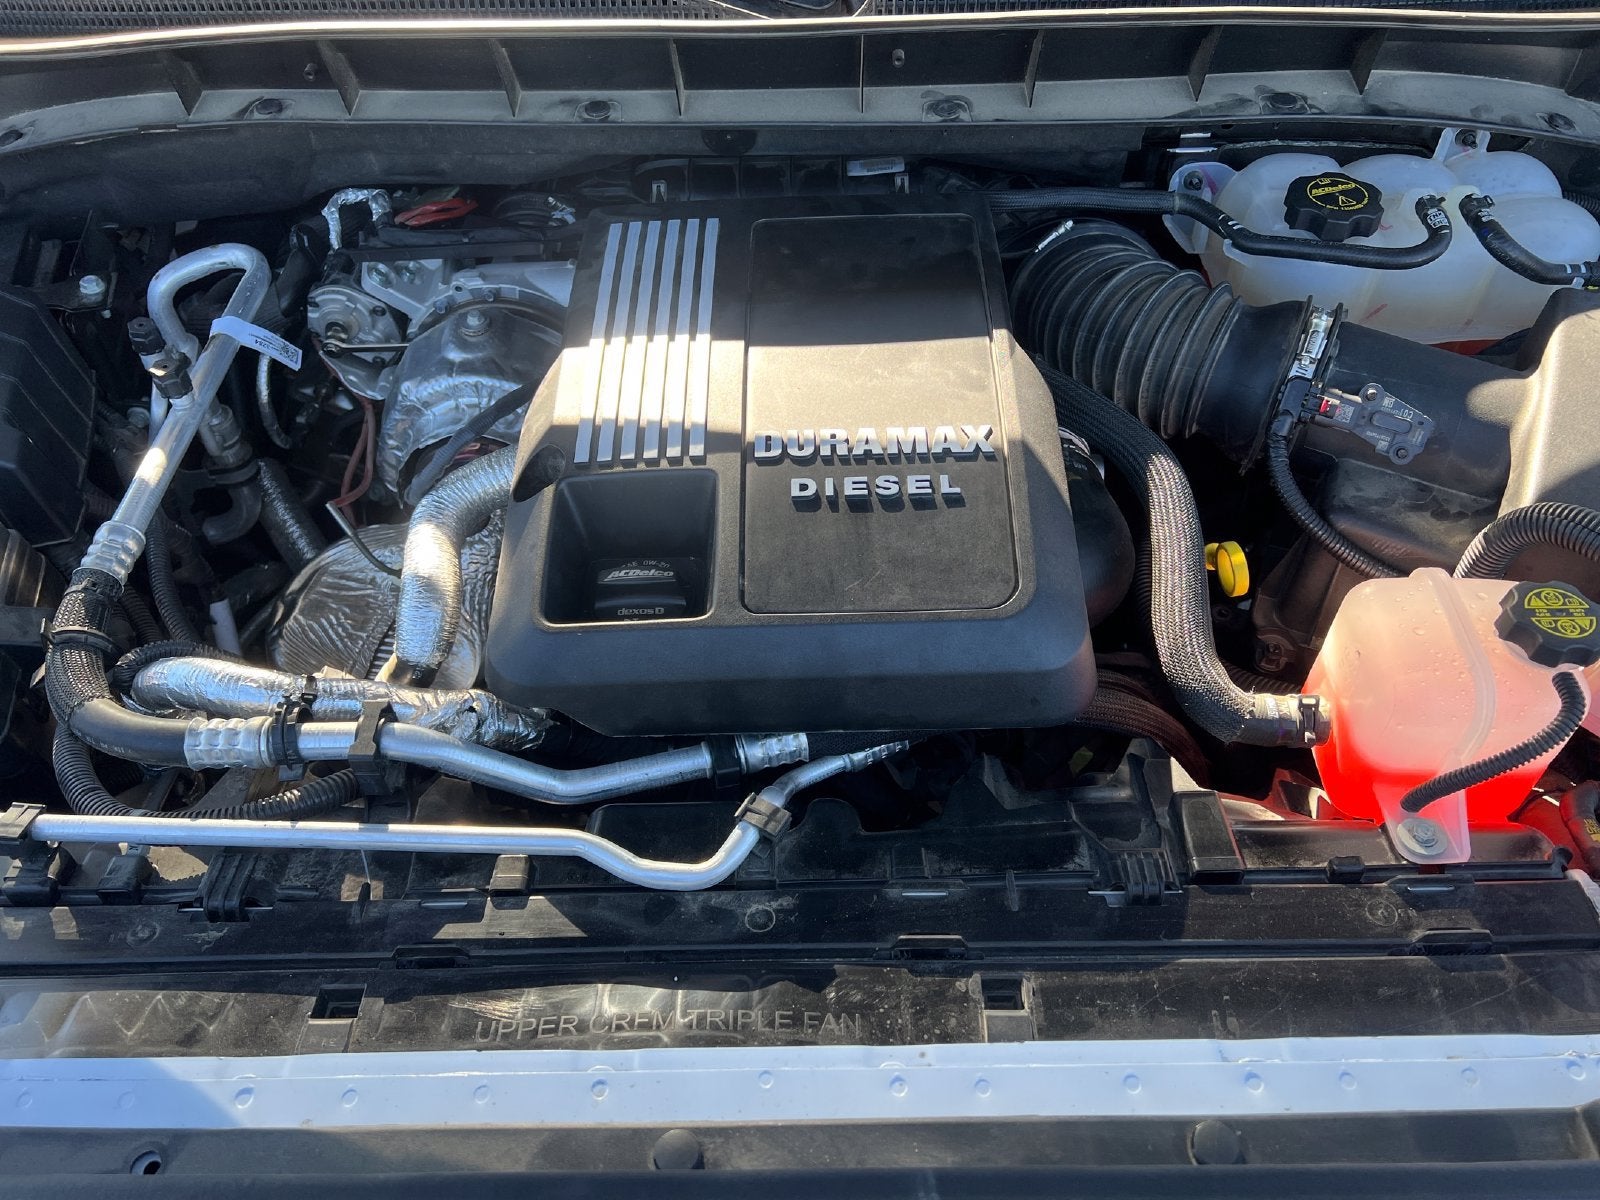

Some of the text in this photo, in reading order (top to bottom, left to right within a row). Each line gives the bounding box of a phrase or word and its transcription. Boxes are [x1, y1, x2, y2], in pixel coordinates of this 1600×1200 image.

[1311, 182, 1356, 197] ACDelco
[754, 424, 995, 460] DURAMAX
[790, 475, 962, 498] DIESEL
[605, 568, 676, 581] ACDelco
[475, 1009, 862, 1044] UPPER CRFM TRIPLE FAN
